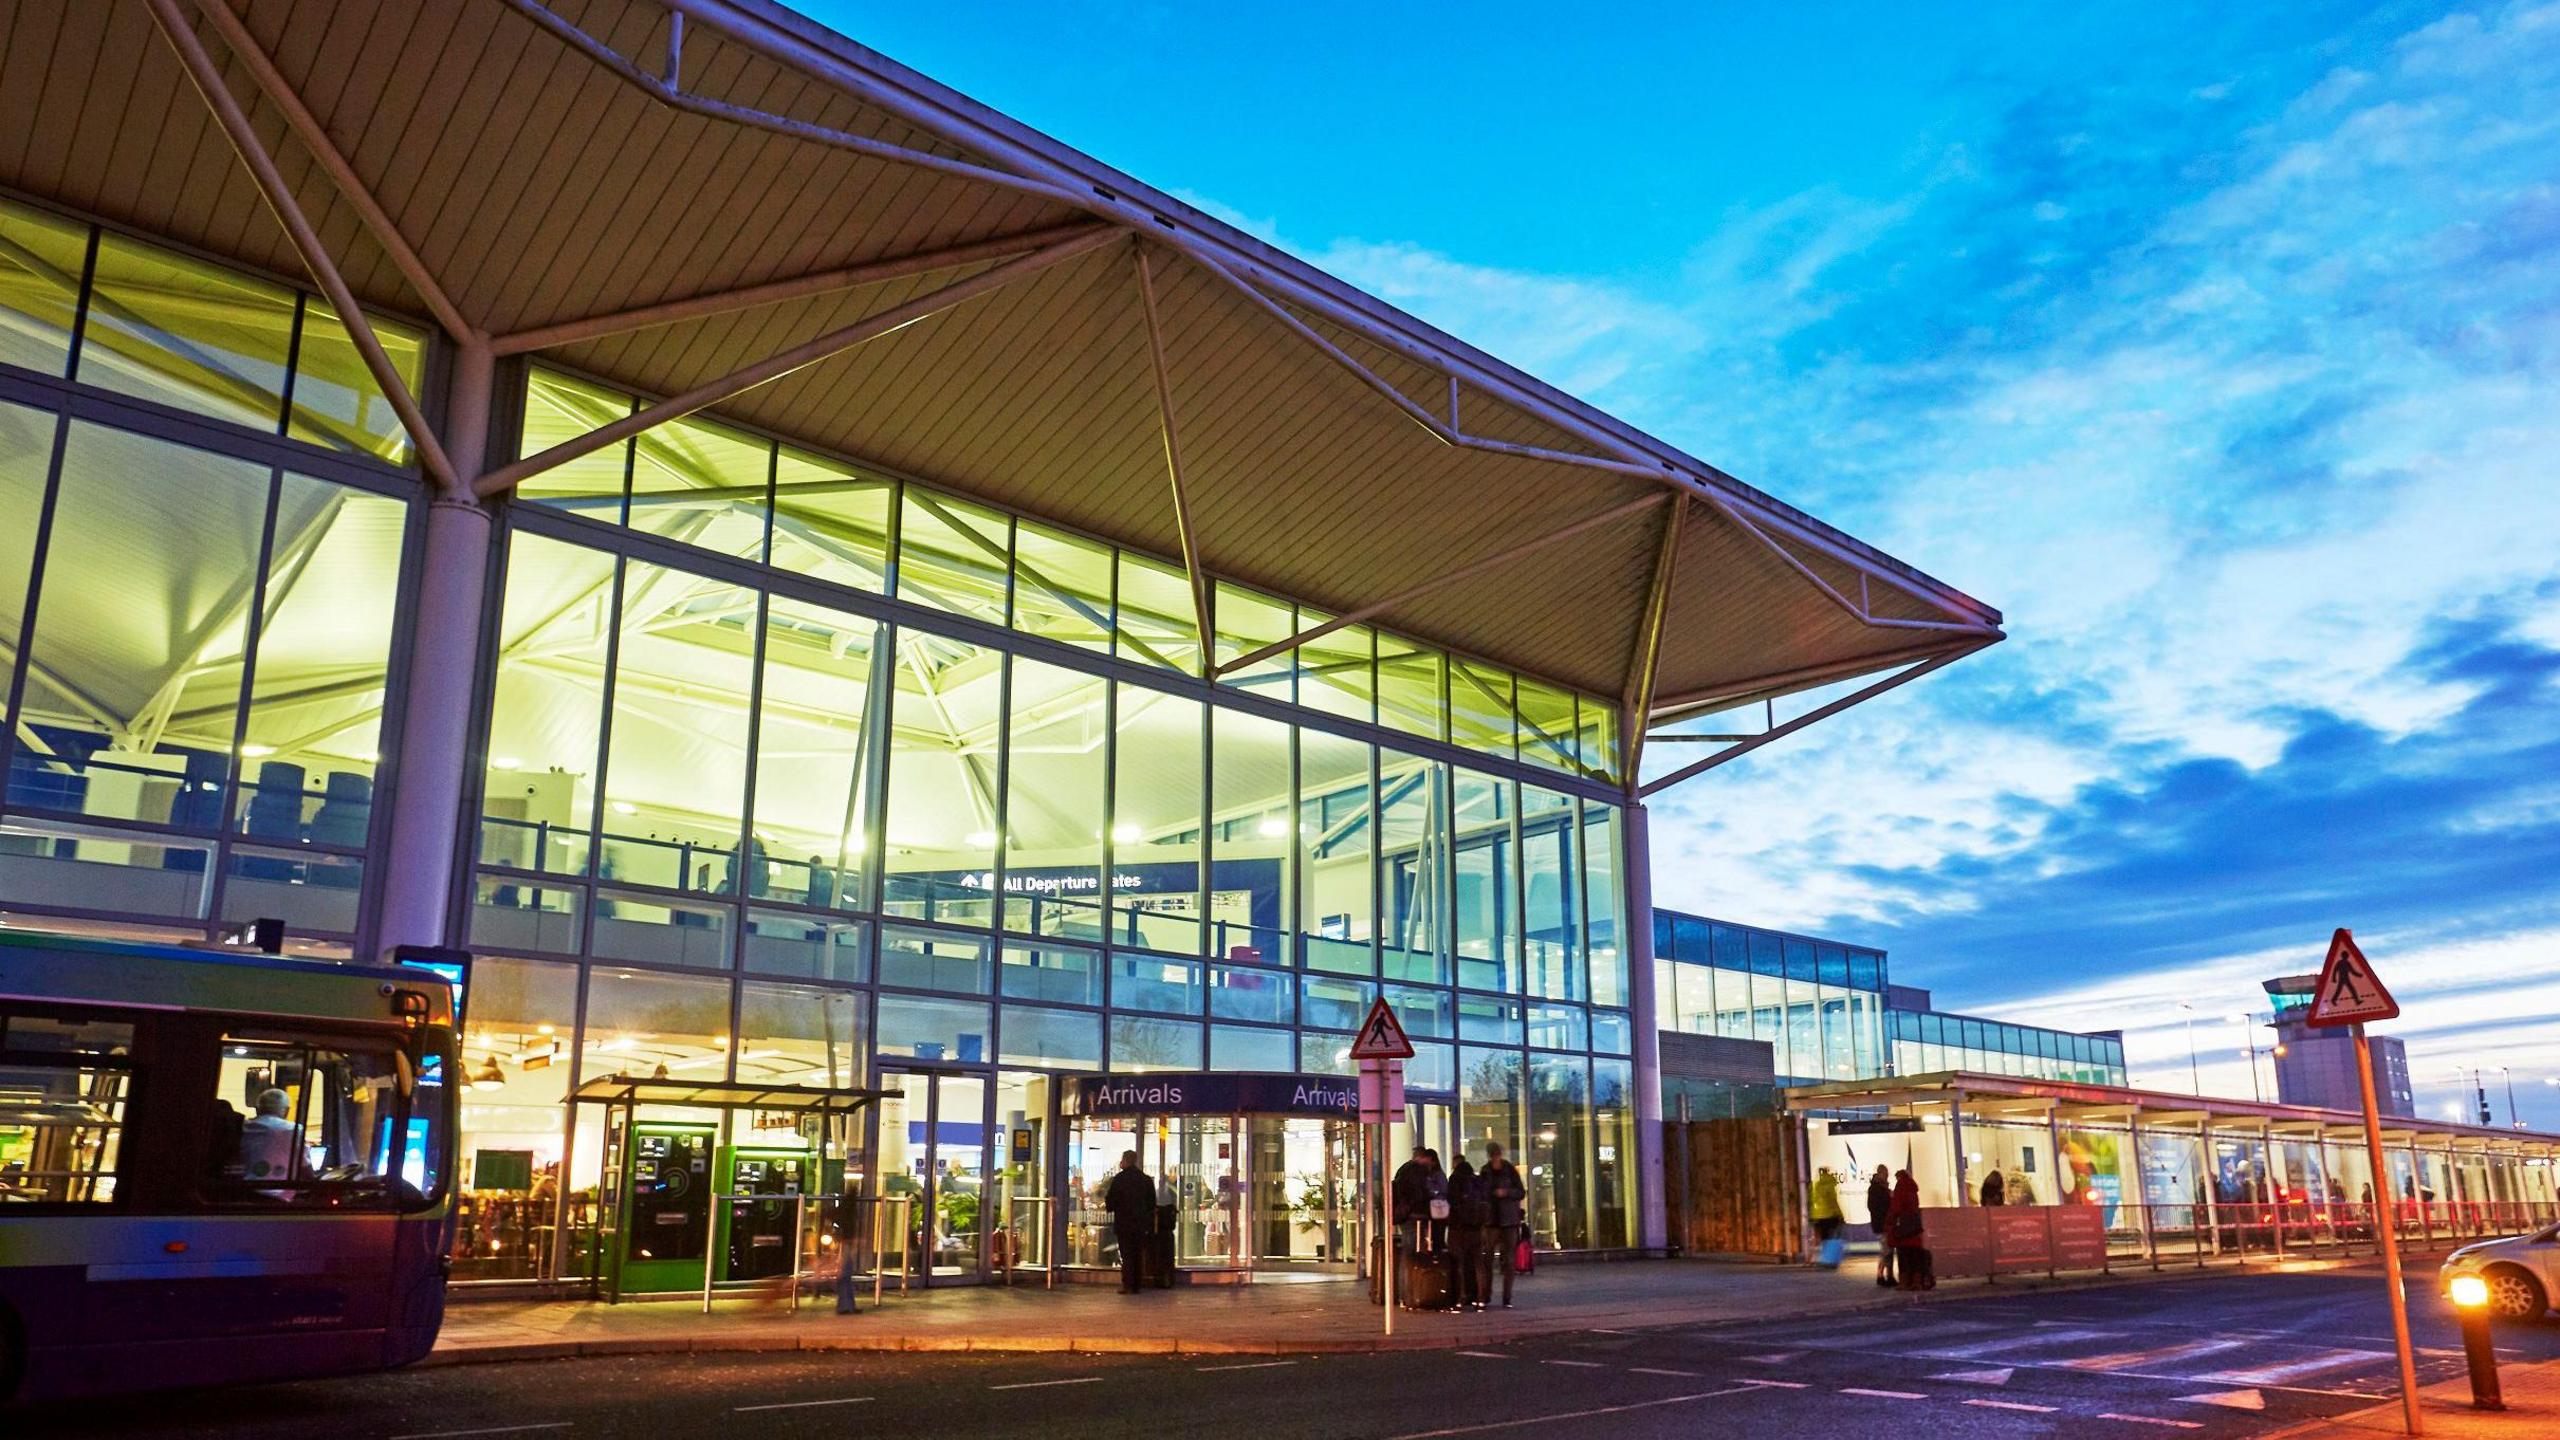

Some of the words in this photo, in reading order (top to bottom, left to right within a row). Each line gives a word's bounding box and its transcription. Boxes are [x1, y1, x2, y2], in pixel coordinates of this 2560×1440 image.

[1003, 877, 1022, 890] All
[1026, 876, 1097, 893] Departure
[1112, 874, 1141, 888] ates
[1097, 1083, 1183, 1105] Arrivals
[1292, 1085, 1358, 1107] Arrivals
